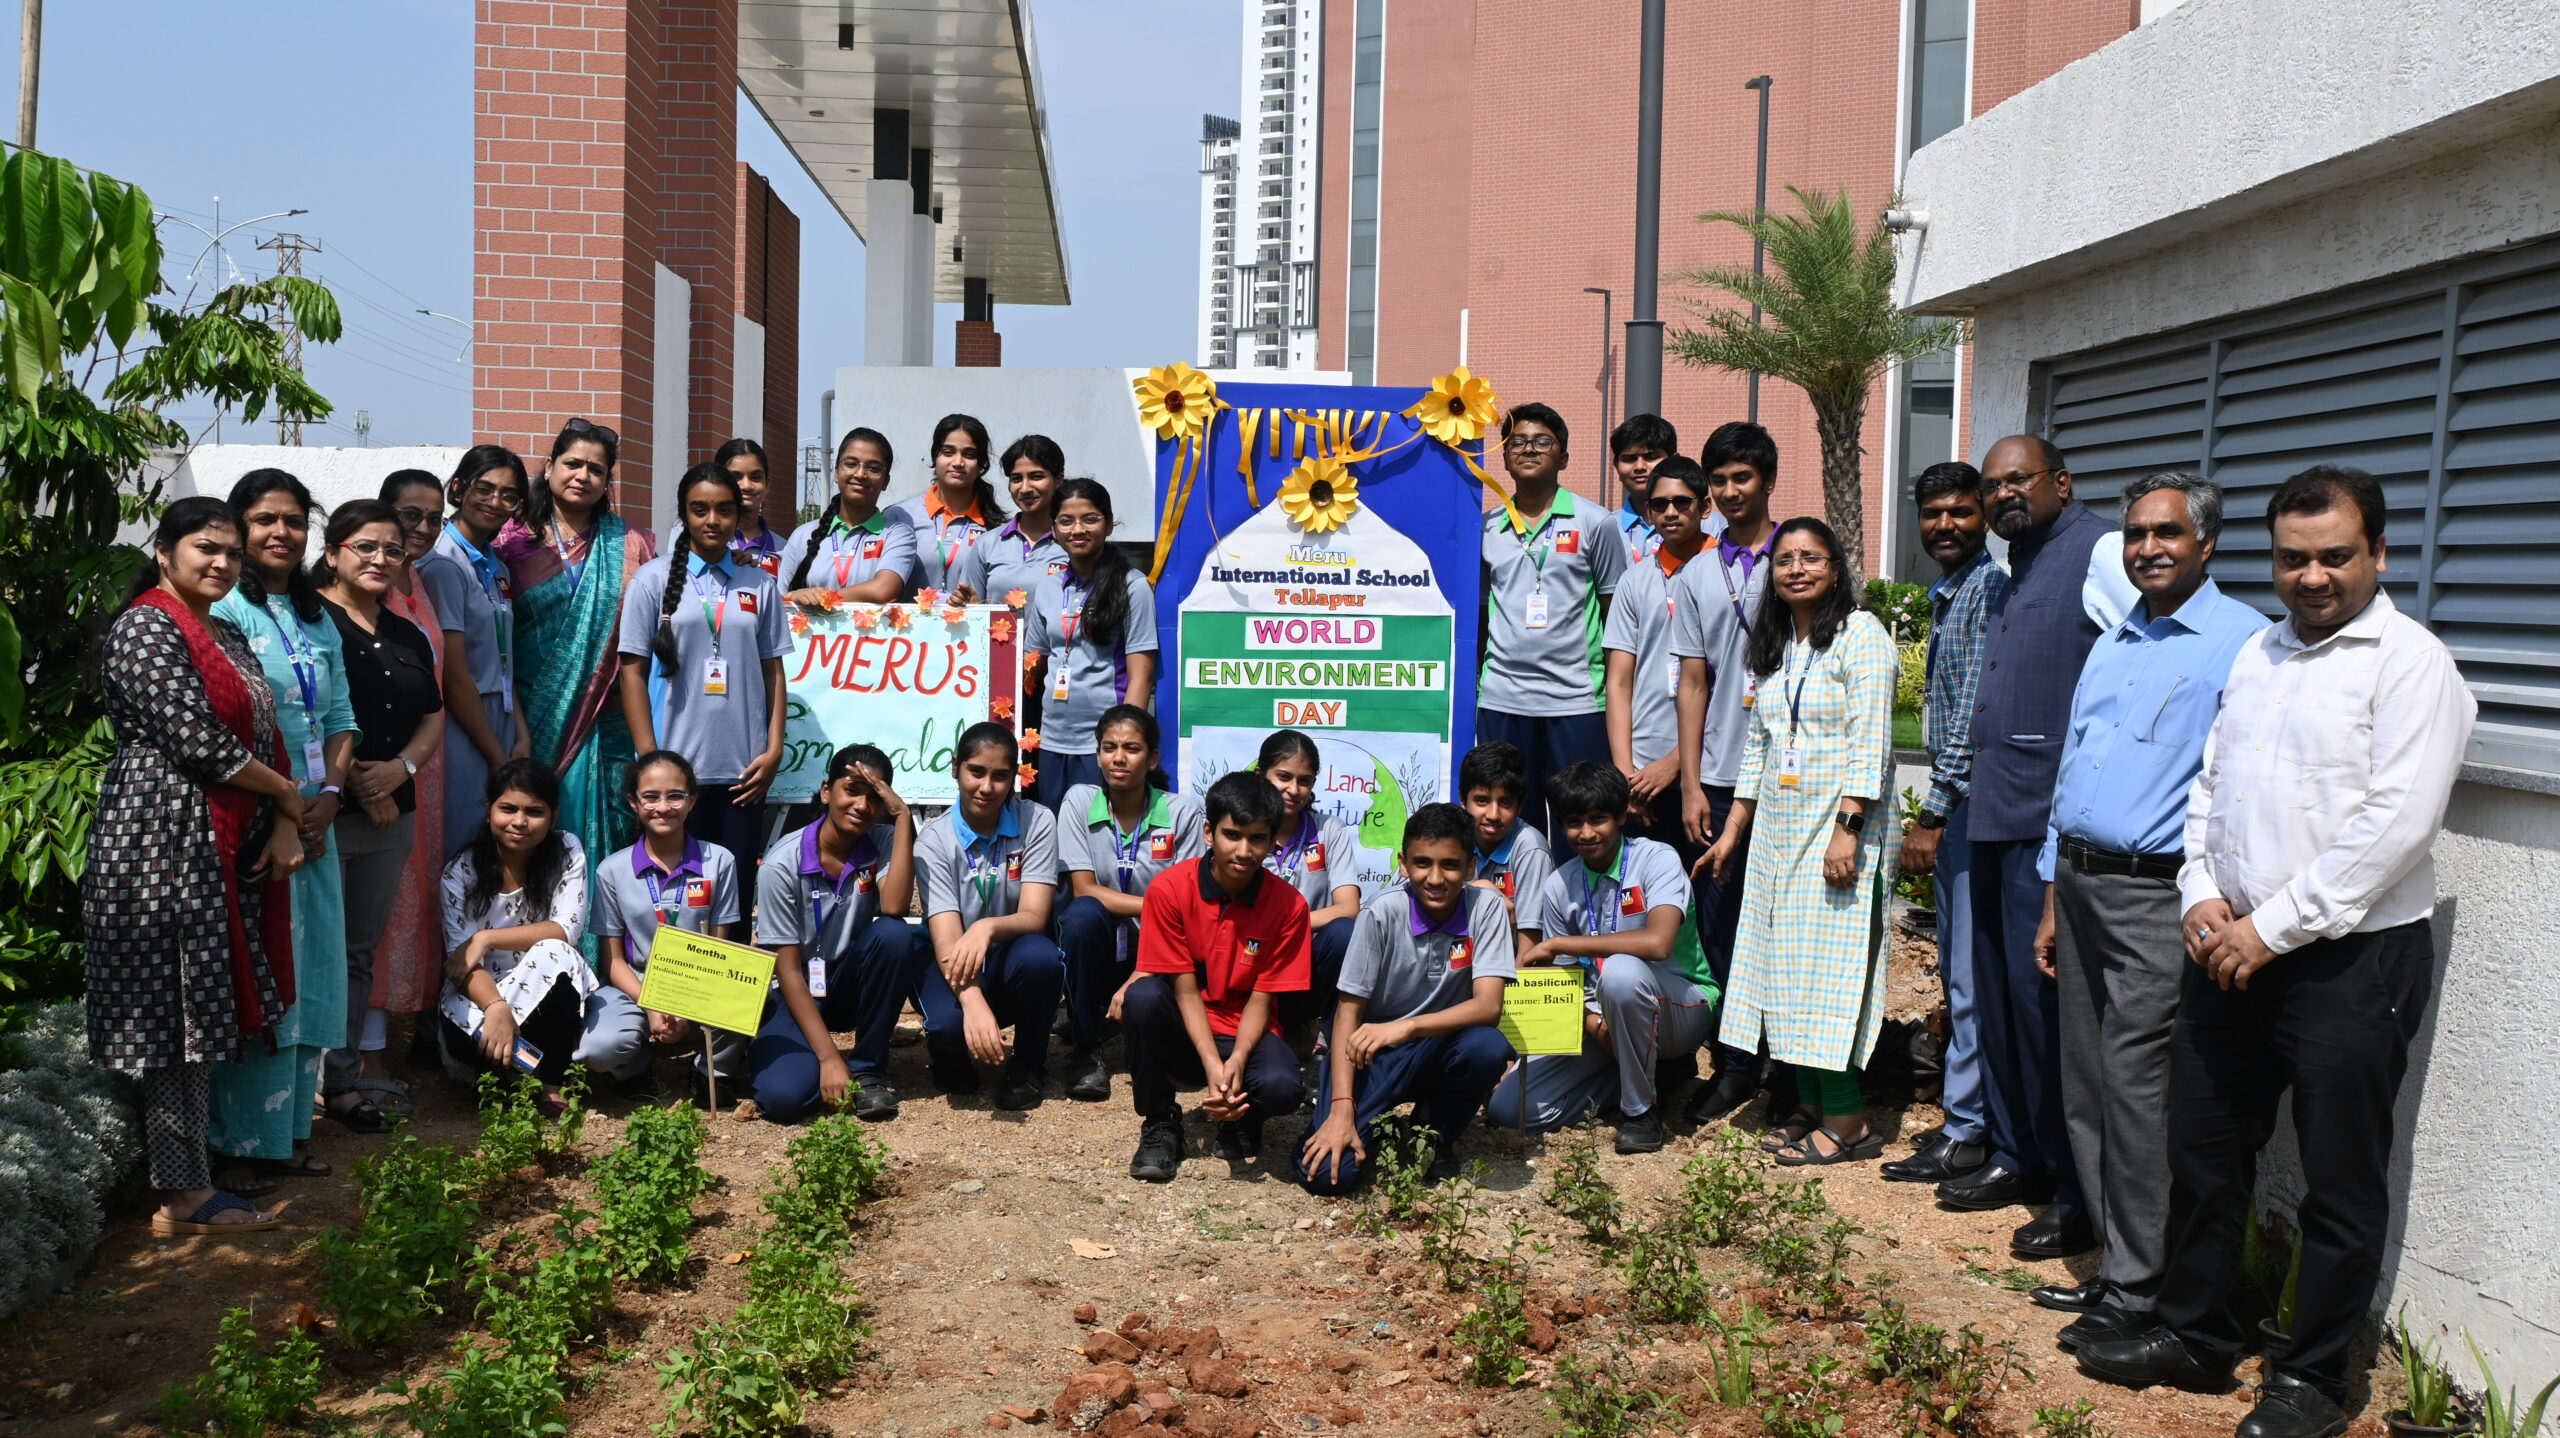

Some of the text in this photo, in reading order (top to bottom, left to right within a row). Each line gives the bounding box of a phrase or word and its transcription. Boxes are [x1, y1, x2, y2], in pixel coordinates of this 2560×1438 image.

[1290, 545, 1347, 564] Meru
[1211, 566, 1430, 587] International School
[1274, 588, 1366, 610] Tellapur
[1254, 619, 1375, 644] WORLD
[788, 634, 979, 698] MERU's
[1198, 661, 1438, 687] ENVIRONMENT
[1277, 701, 1342, 726] DAY
[1325, 765, 1378, 794] Land
[690, 884, 702, 894] M
[686, 943, 727, 961] Mentha
[1248, 941, 1259, 952] M
[652, 965, 684, 977] Medicinal
[653, 953, 758, 985] Common name: Mint
[1524, 979, 1578, 987] basilicum
[1543, 993, 1574, 1004] Basil
